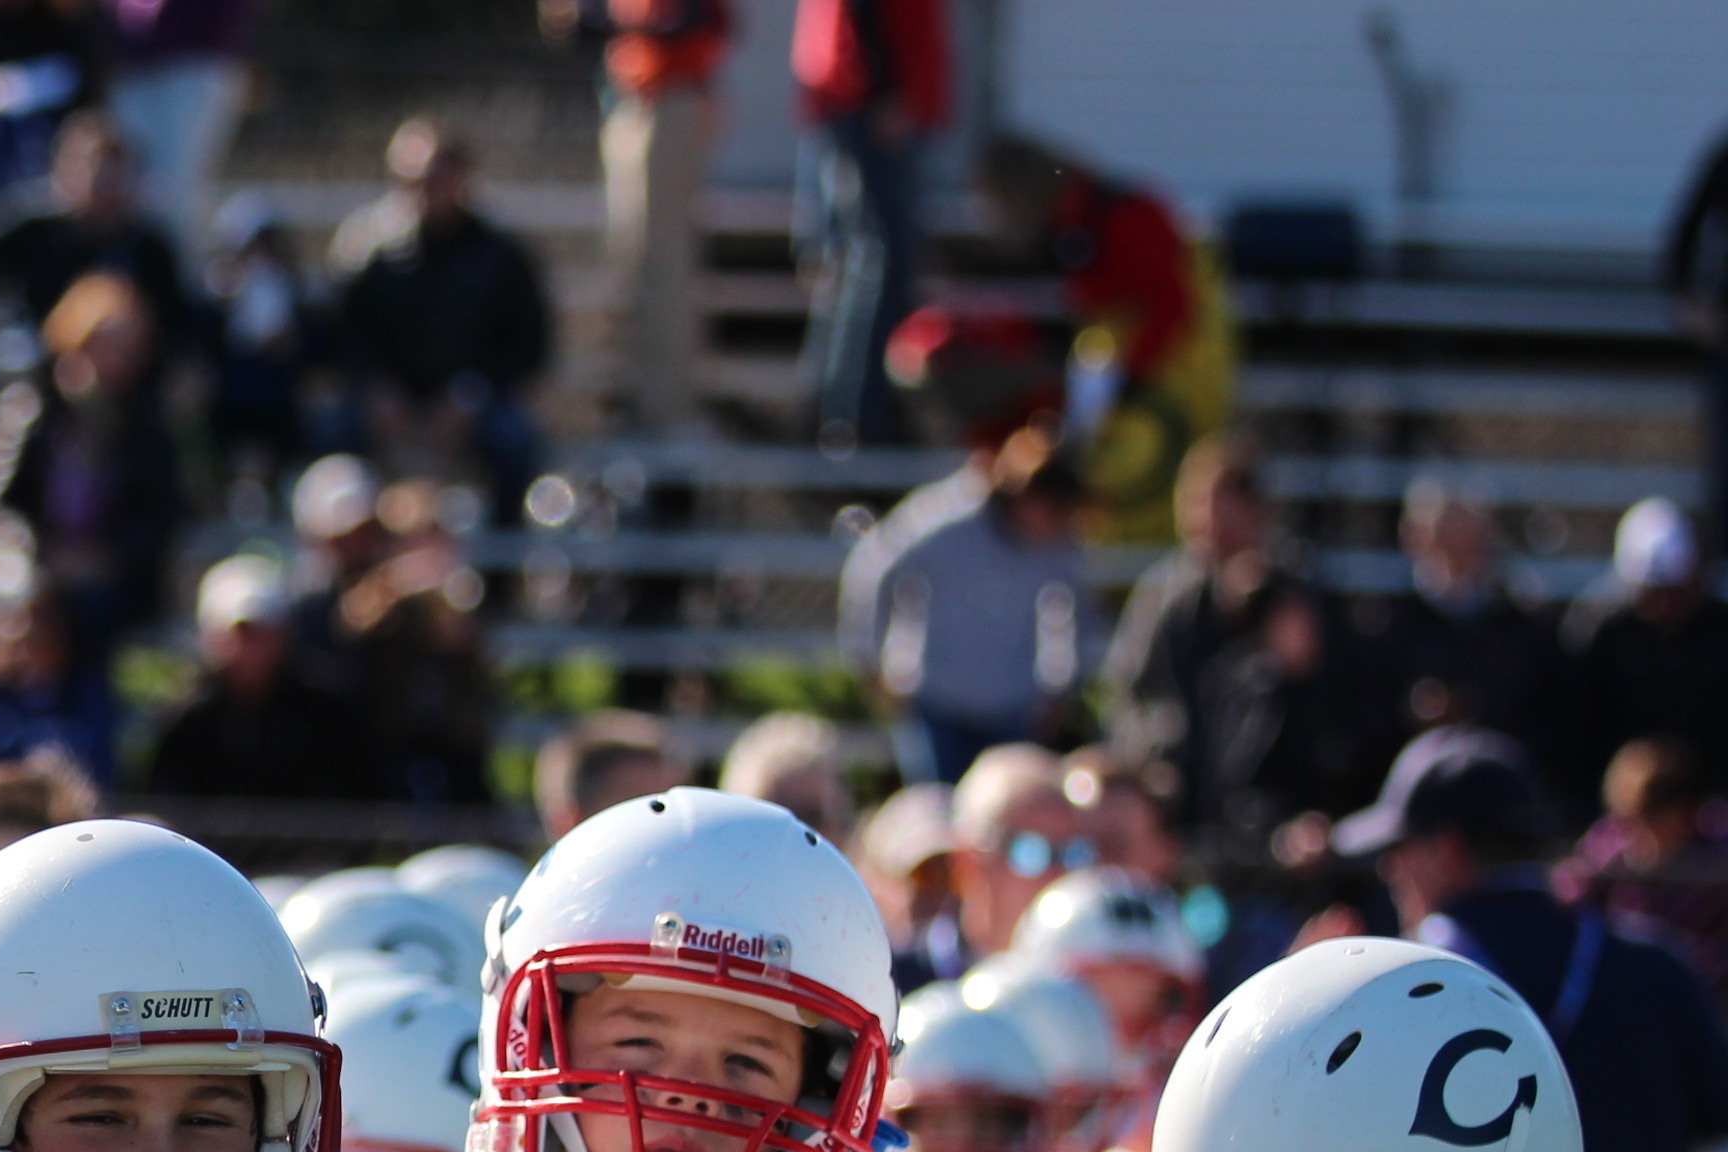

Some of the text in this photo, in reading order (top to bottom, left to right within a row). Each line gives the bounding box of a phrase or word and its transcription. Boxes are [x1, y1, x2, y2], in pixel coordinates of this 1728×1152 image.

[683, 924, 764, 958] Riddell
[141, 997, 213, 1019] SCHUTT
[1408, 1028, 1538, 1147] C
